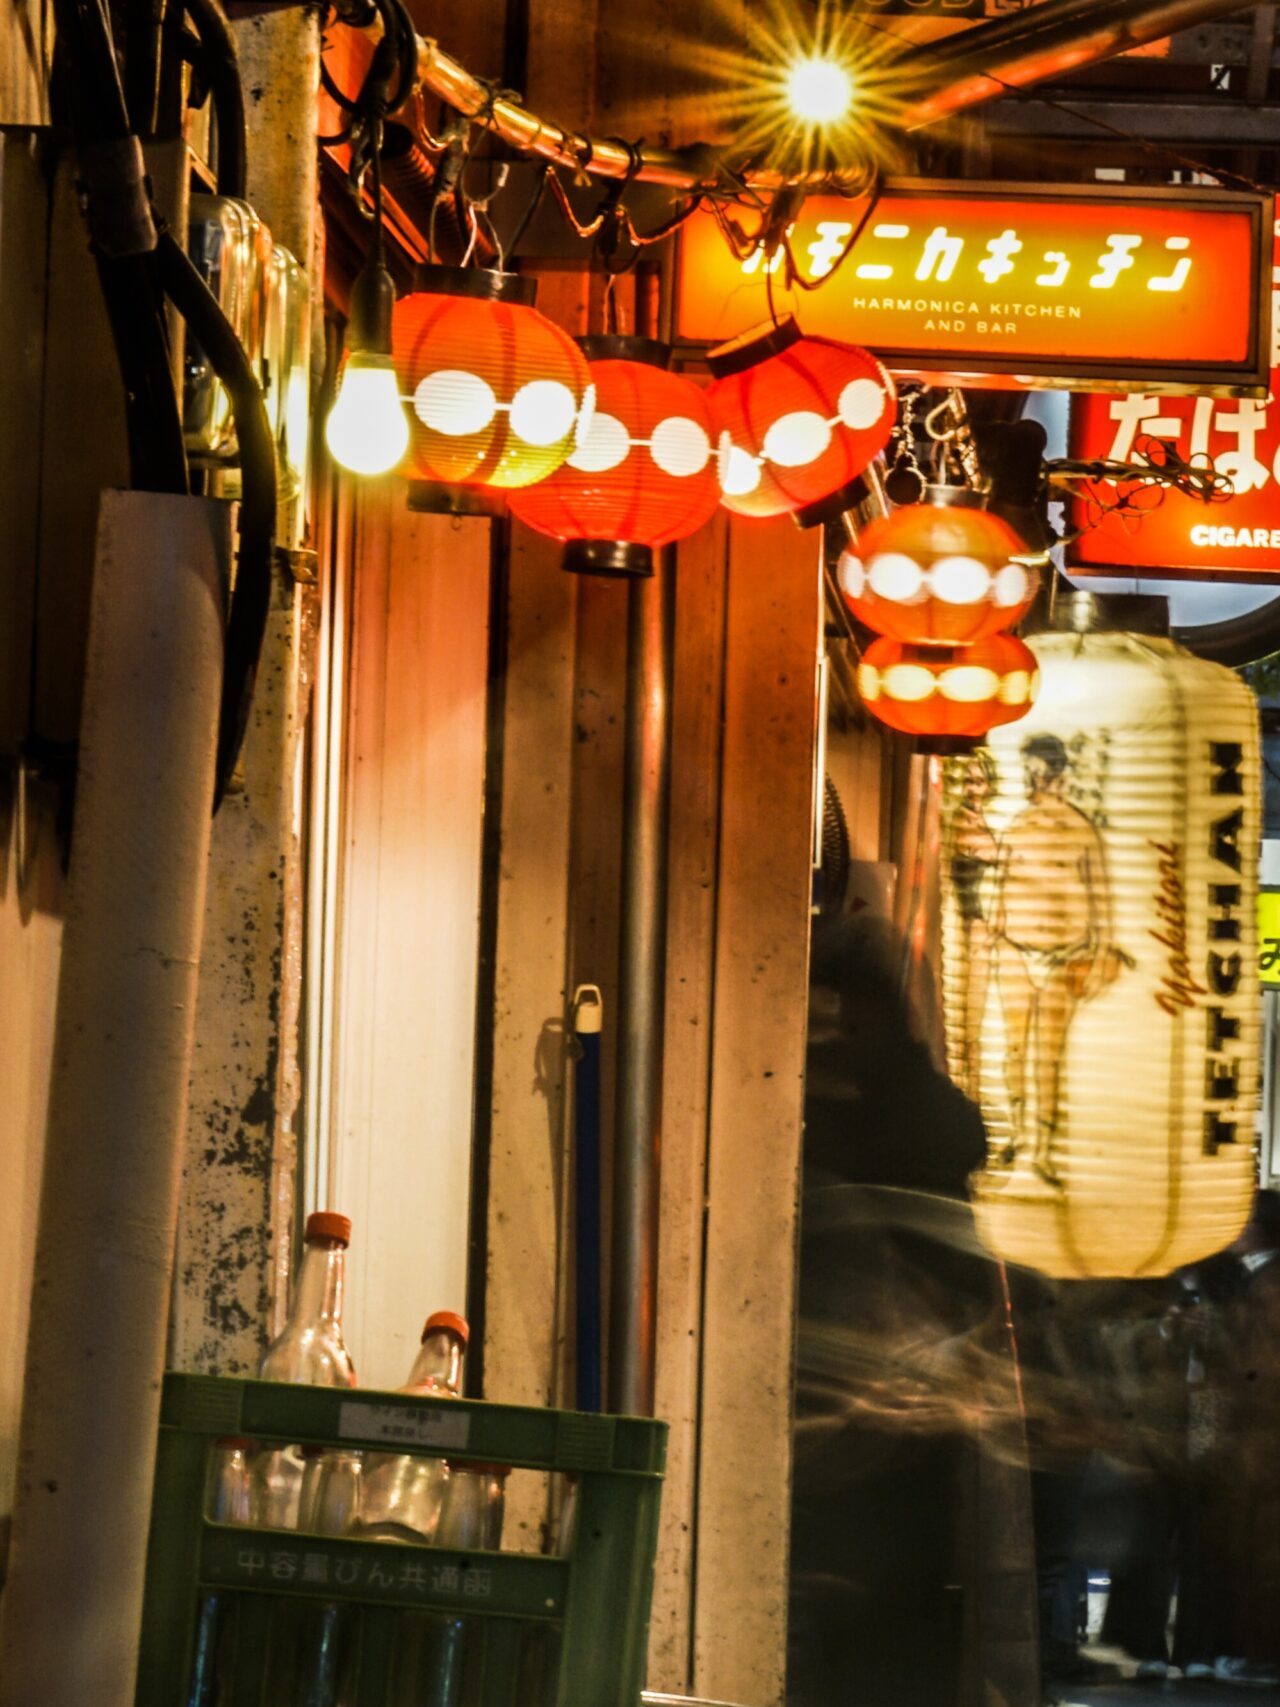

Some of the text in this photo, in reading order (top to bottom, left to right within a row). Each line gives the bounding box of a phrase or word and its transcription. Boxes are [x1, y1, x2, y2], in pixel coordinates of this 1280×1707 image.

[853, 296, 1082, 319] HARMONICA KITCHEN
[923, 319, 1018, 336] AND BAR
[1147, 839, 1207, 1017] Yakitori
[1204, 741, 1243, 1156] TETCHAN
